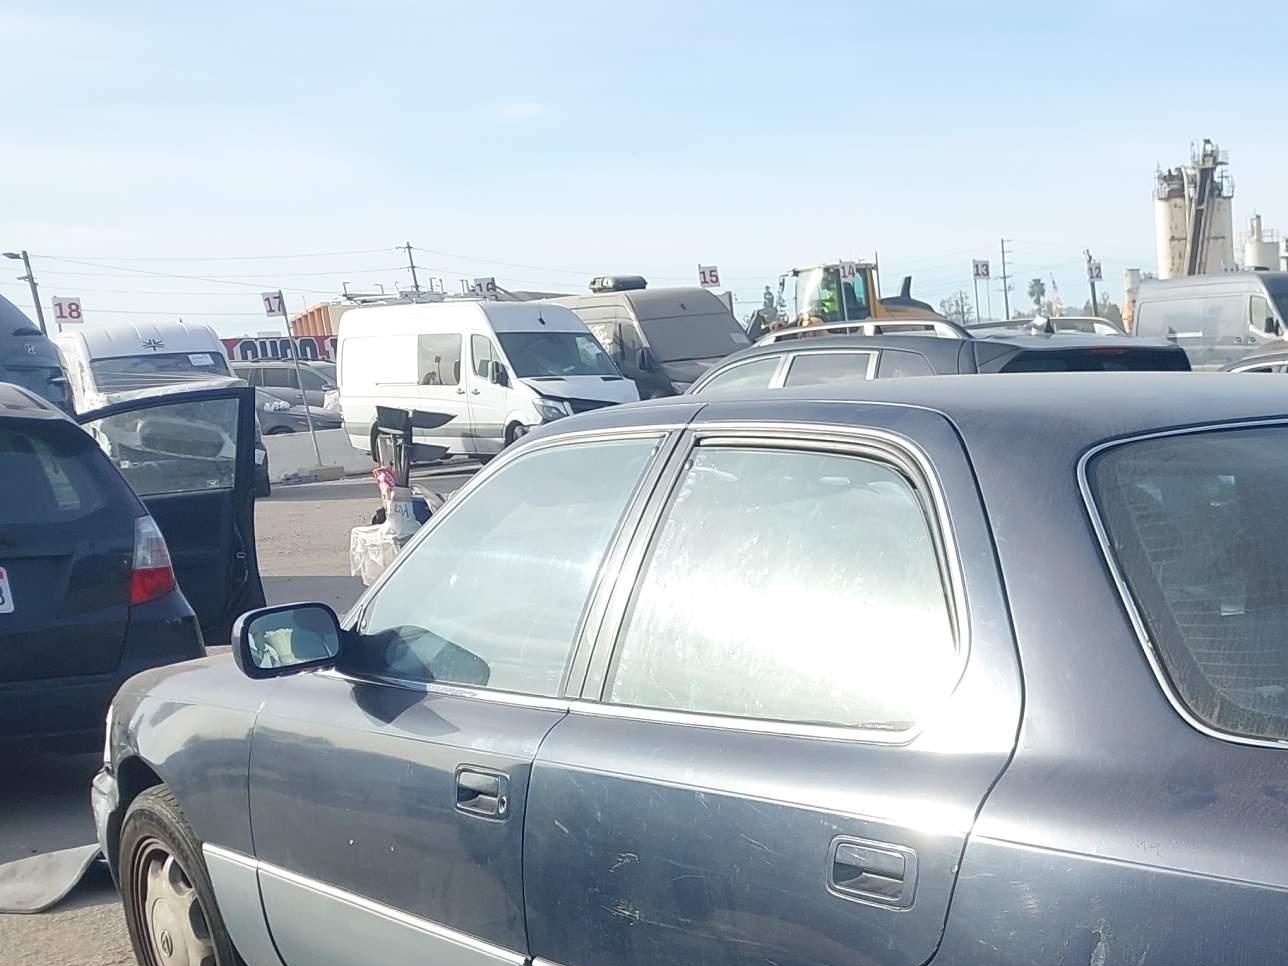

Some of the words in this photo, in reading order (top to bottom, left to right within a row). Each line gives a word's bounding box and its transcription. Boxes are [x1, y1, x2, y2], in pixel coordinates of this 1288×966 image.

[841, 265, 856, 279] 14
[974, 263, 990, 277] 13
[1087, 265, 1102, 279] 12
[700, 270, 720, 285] 15
[54, 302, 82, 320] 18
[263, 295, 283, 314] 17
